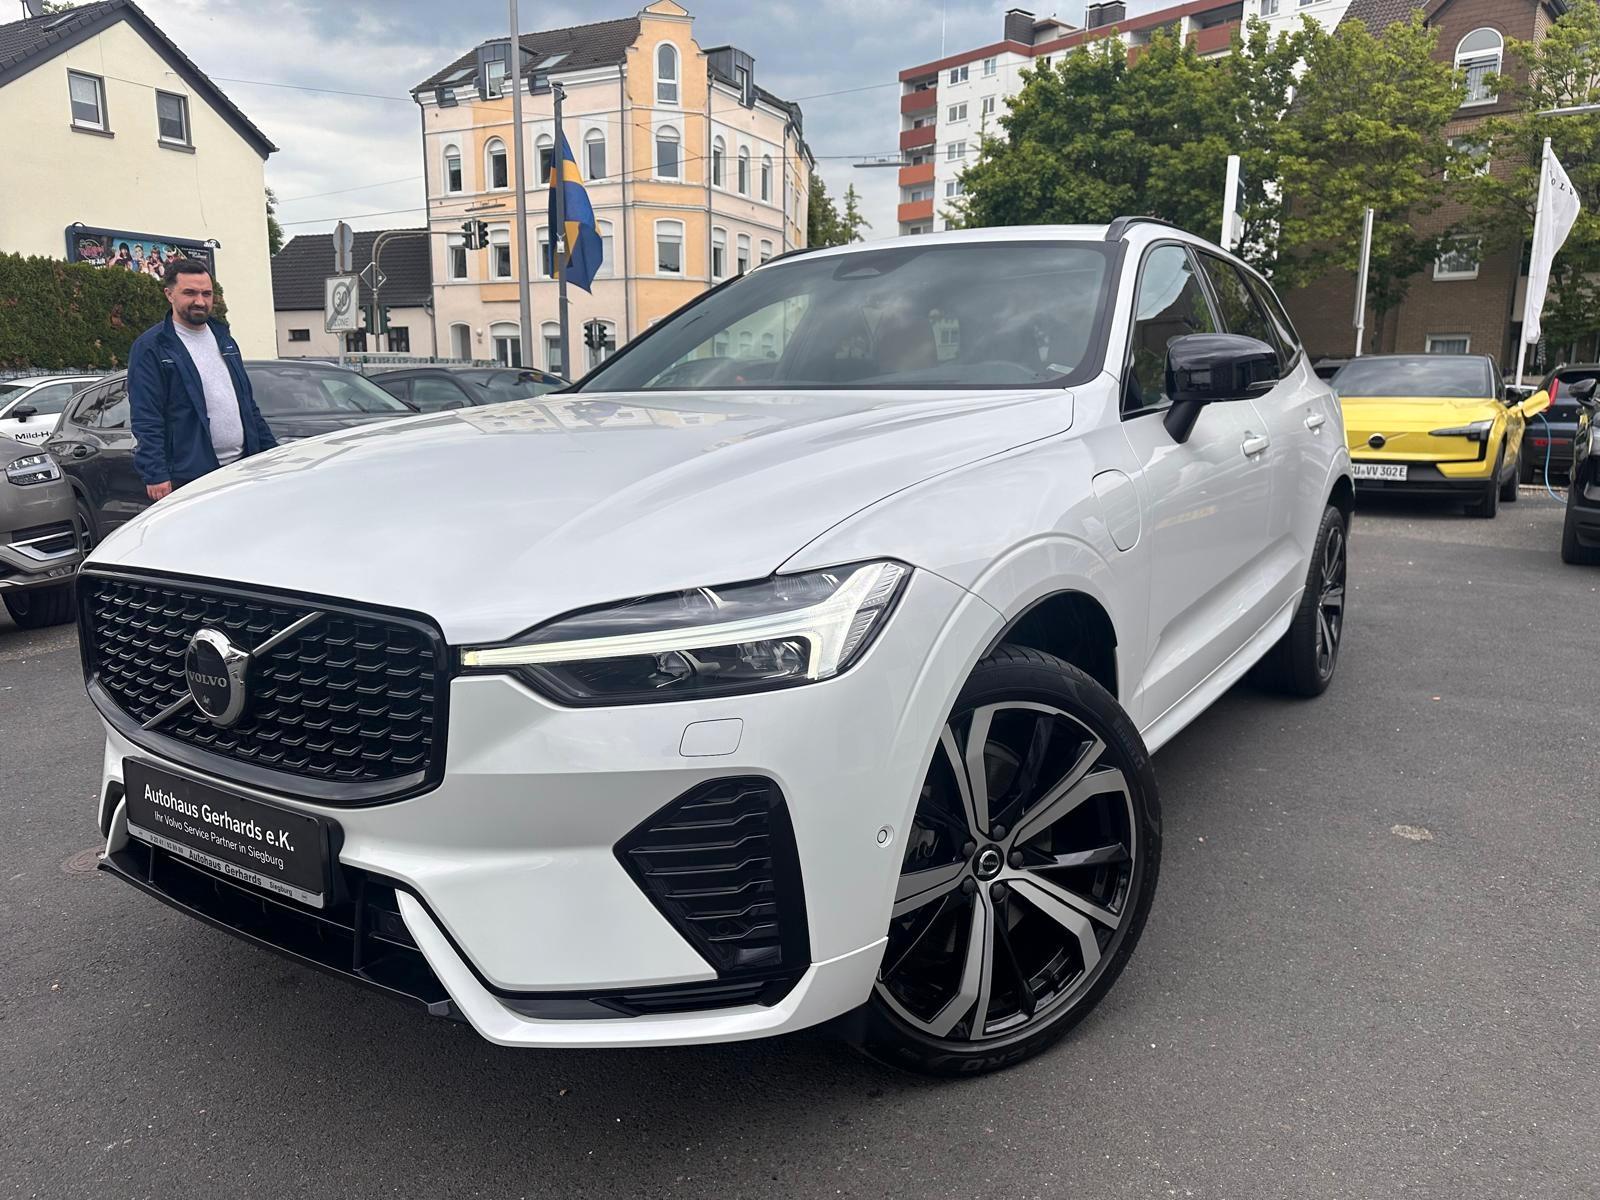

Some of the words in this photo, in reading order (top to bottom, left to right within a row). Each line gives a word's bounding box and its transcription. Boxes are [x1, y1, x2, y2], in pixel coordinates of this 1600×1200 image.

[1549, 170, 1579, 200] OLV
[336, 291, 348, 307] 30
[15, 430, 52, 440] Mild-H
[1351, 465, 1360, 475] U
[189, 670, 227, 688] VOLVO
[144, 783, 199, 819] Autohaus
[201, 804, 262, 841] Gerhards
[265, 829, 295, 852] e.K.
[154, 810, 164, 823] Ihr
[164, 814, 183, 831] Volvo
[183, 821, 210, 841] Service
[210, 831, 238, 850] Partner
[238, 841, 246, 854] in
[247, 845, 284, 870] Siegburg
[188, 849, 222, 871] Autohaus
[224, 864, 262, 886] Gerhards
[269, 881, 293, 897] Siegburg
